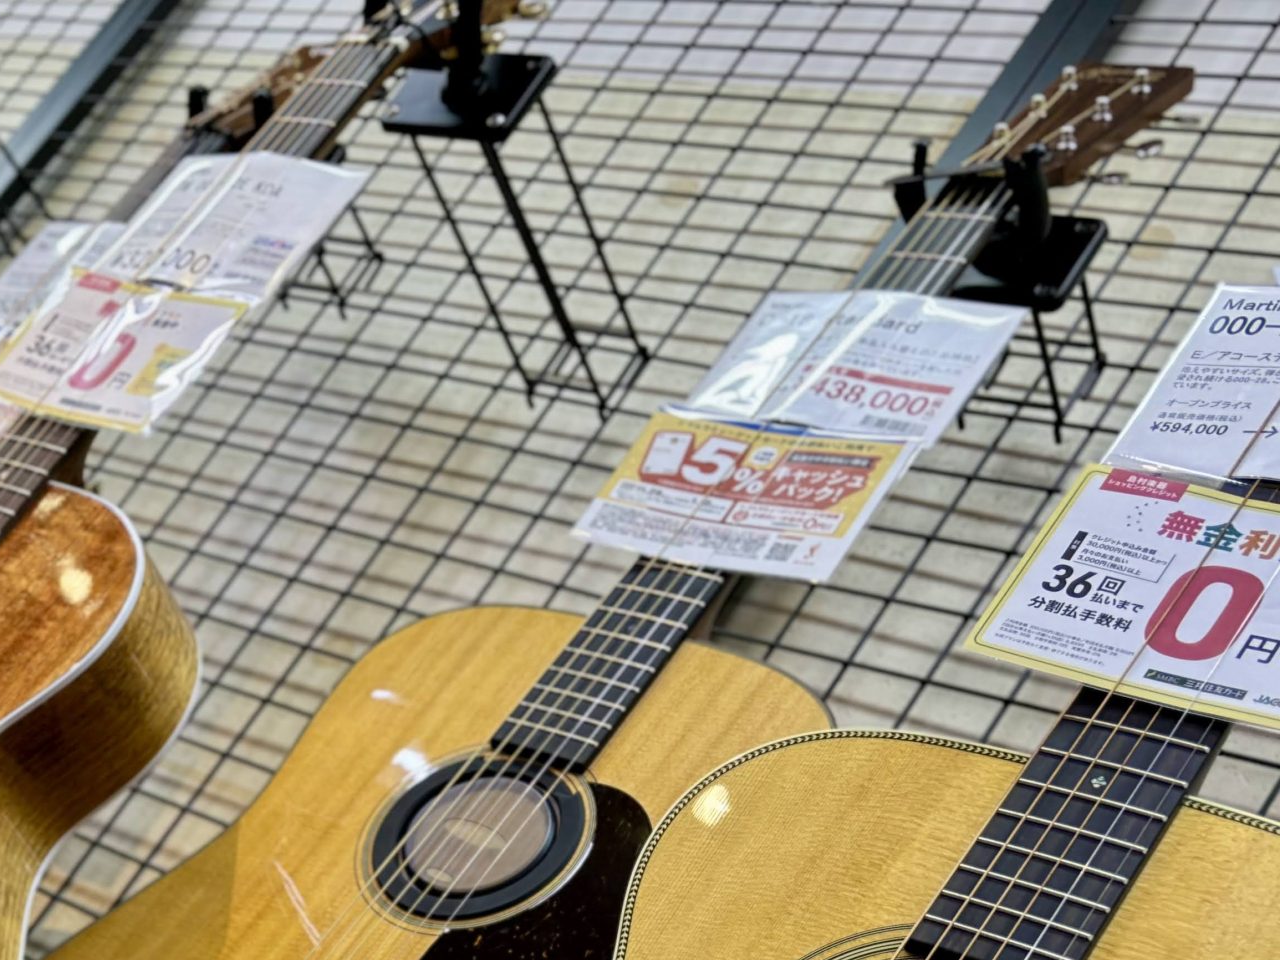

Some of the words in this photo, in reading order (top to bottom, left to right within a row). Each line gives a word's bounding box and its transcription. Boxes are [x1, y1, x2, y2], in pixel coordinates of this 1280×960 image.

[1223, 298, 1280, 312] Marti
[1209, 315, 1280, 336] 000-
[1150, 421, 1229, 436] ¥594,000
[1028, 596, 1133, 632] 分割払手数料
